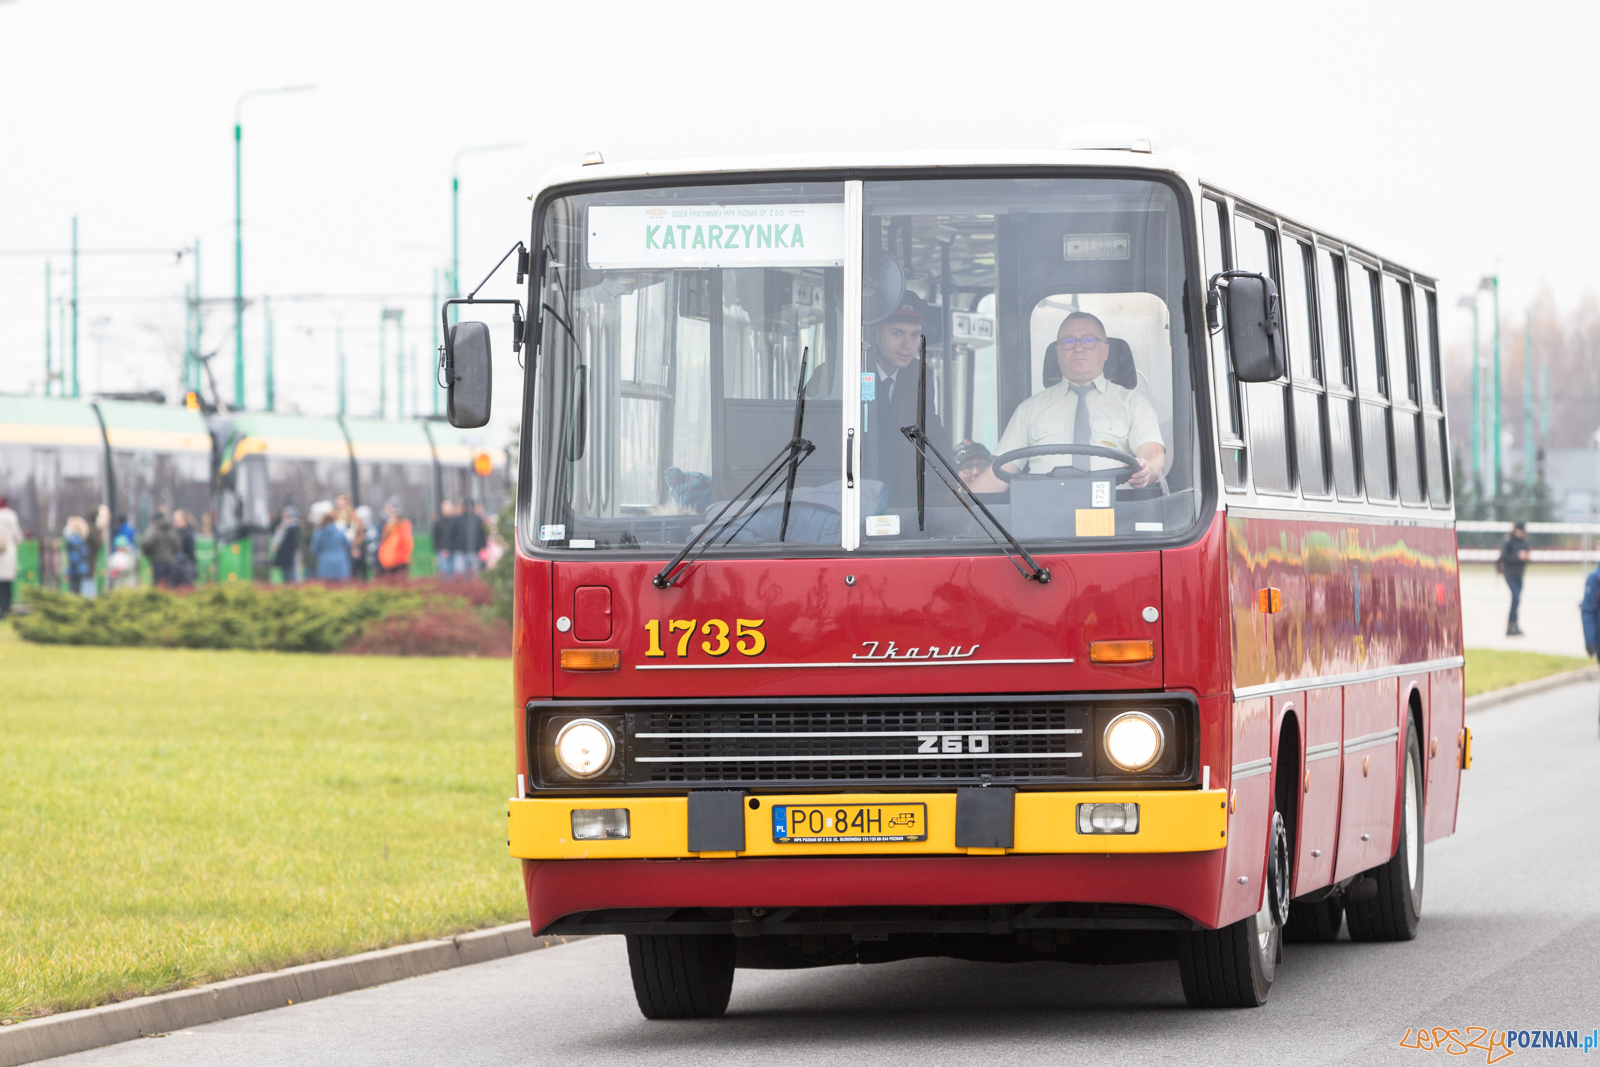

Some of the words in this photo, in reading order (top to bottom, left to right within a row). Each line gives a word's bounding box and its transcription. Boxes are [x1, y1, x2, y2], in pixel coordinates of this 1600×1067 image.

[645, 223, 805, 249] KATARZYNKA
[1095, 483, 1105, 505] 1735
[644, 618, 767, 658] 1735
[852, 641, 980, 659] Ikarus
[776, 825, 786, 833] PL
[791, 809, 824, 834] PO
[834, 808, 882, 834] 84H
